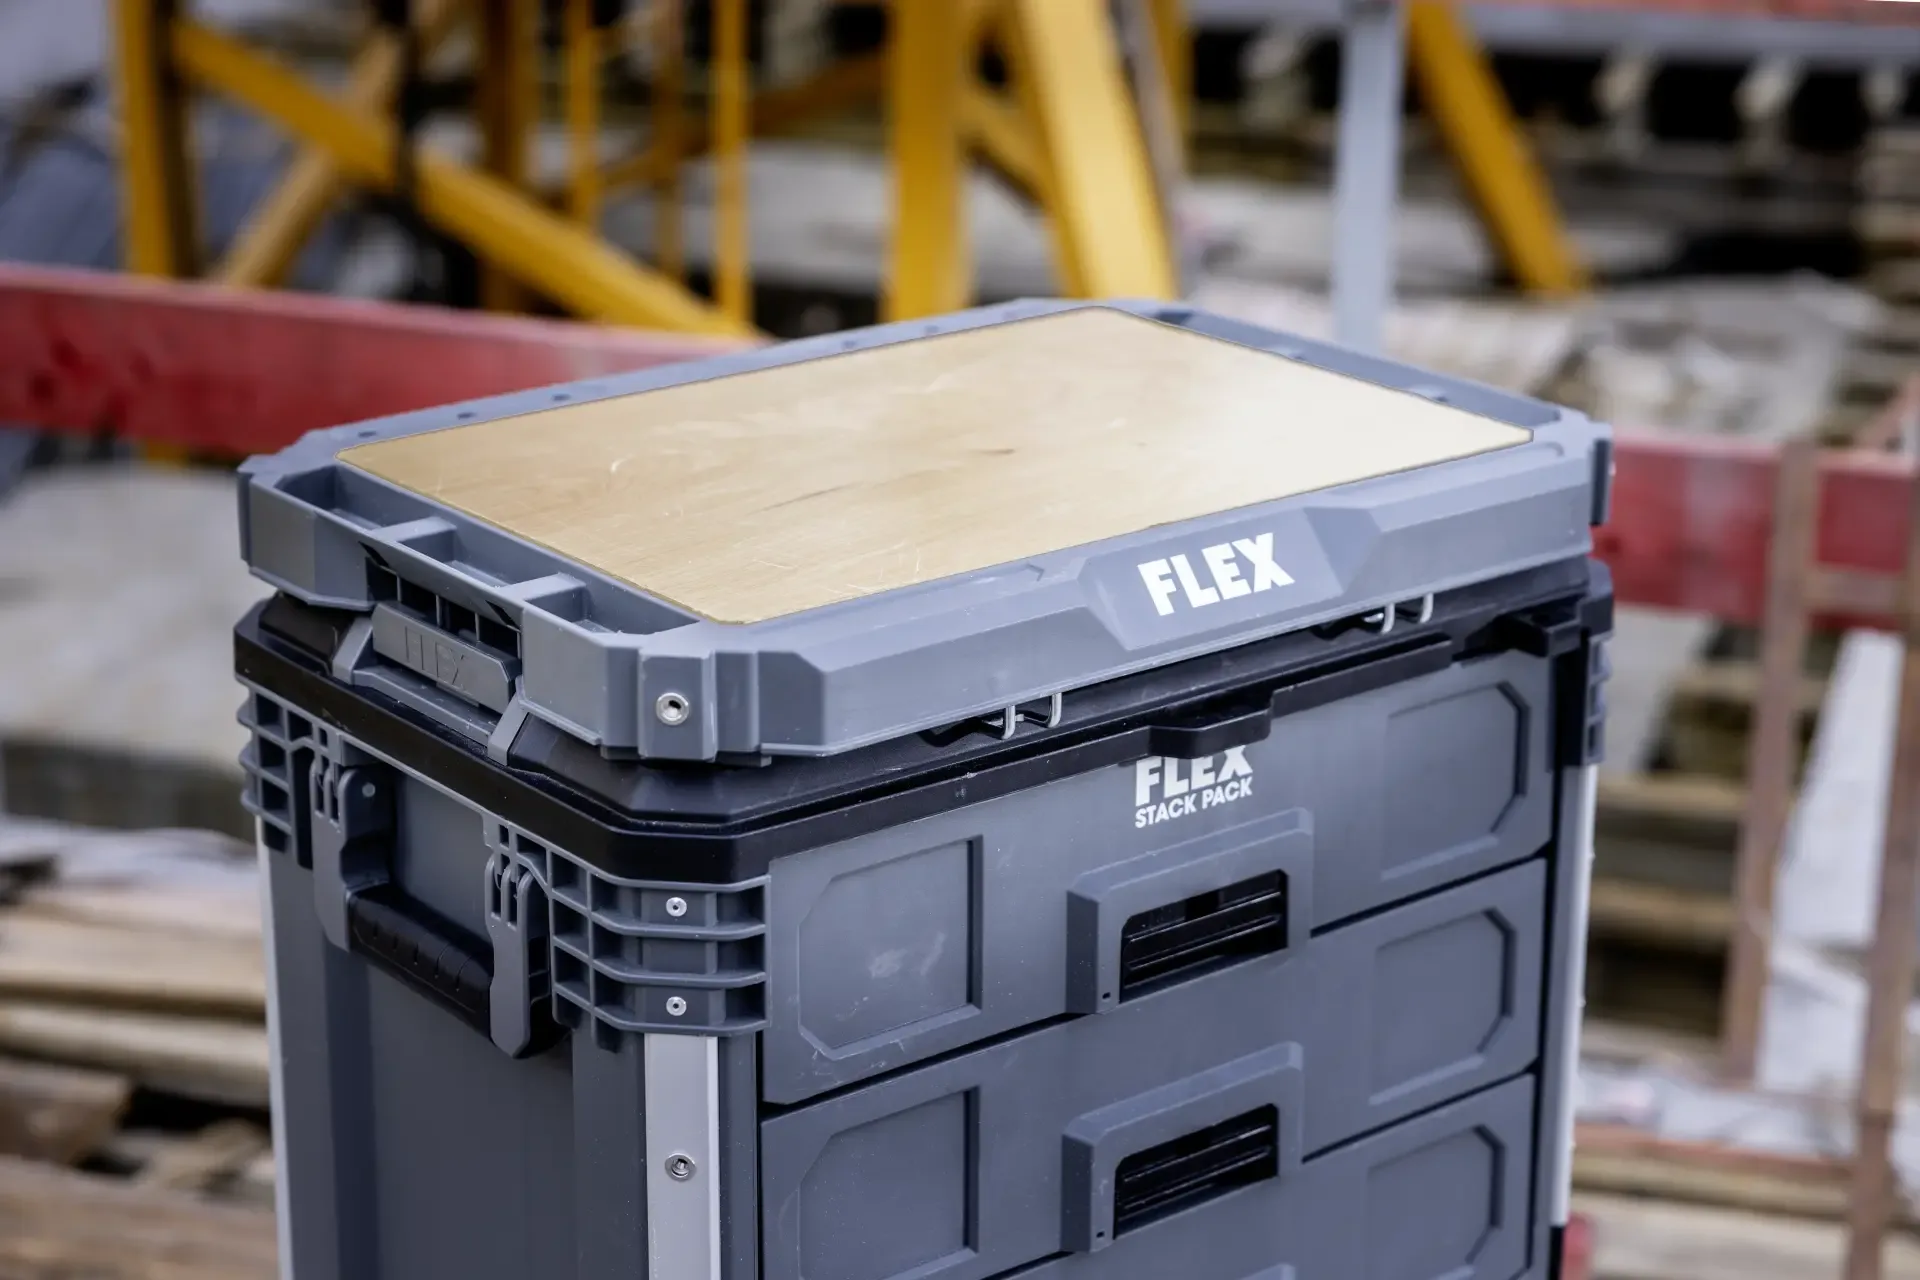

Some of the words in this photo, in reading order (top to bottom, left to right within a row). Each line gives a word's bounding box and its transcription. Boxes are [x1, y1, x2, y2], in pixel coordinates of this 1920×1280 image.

[1137, 532, 1295, 616] FLEX
[1135, 745, 1252, 806] FLEX
[1135, 793, 1196, 829] STACK
[1202, 776, 1252, 809] PACK
